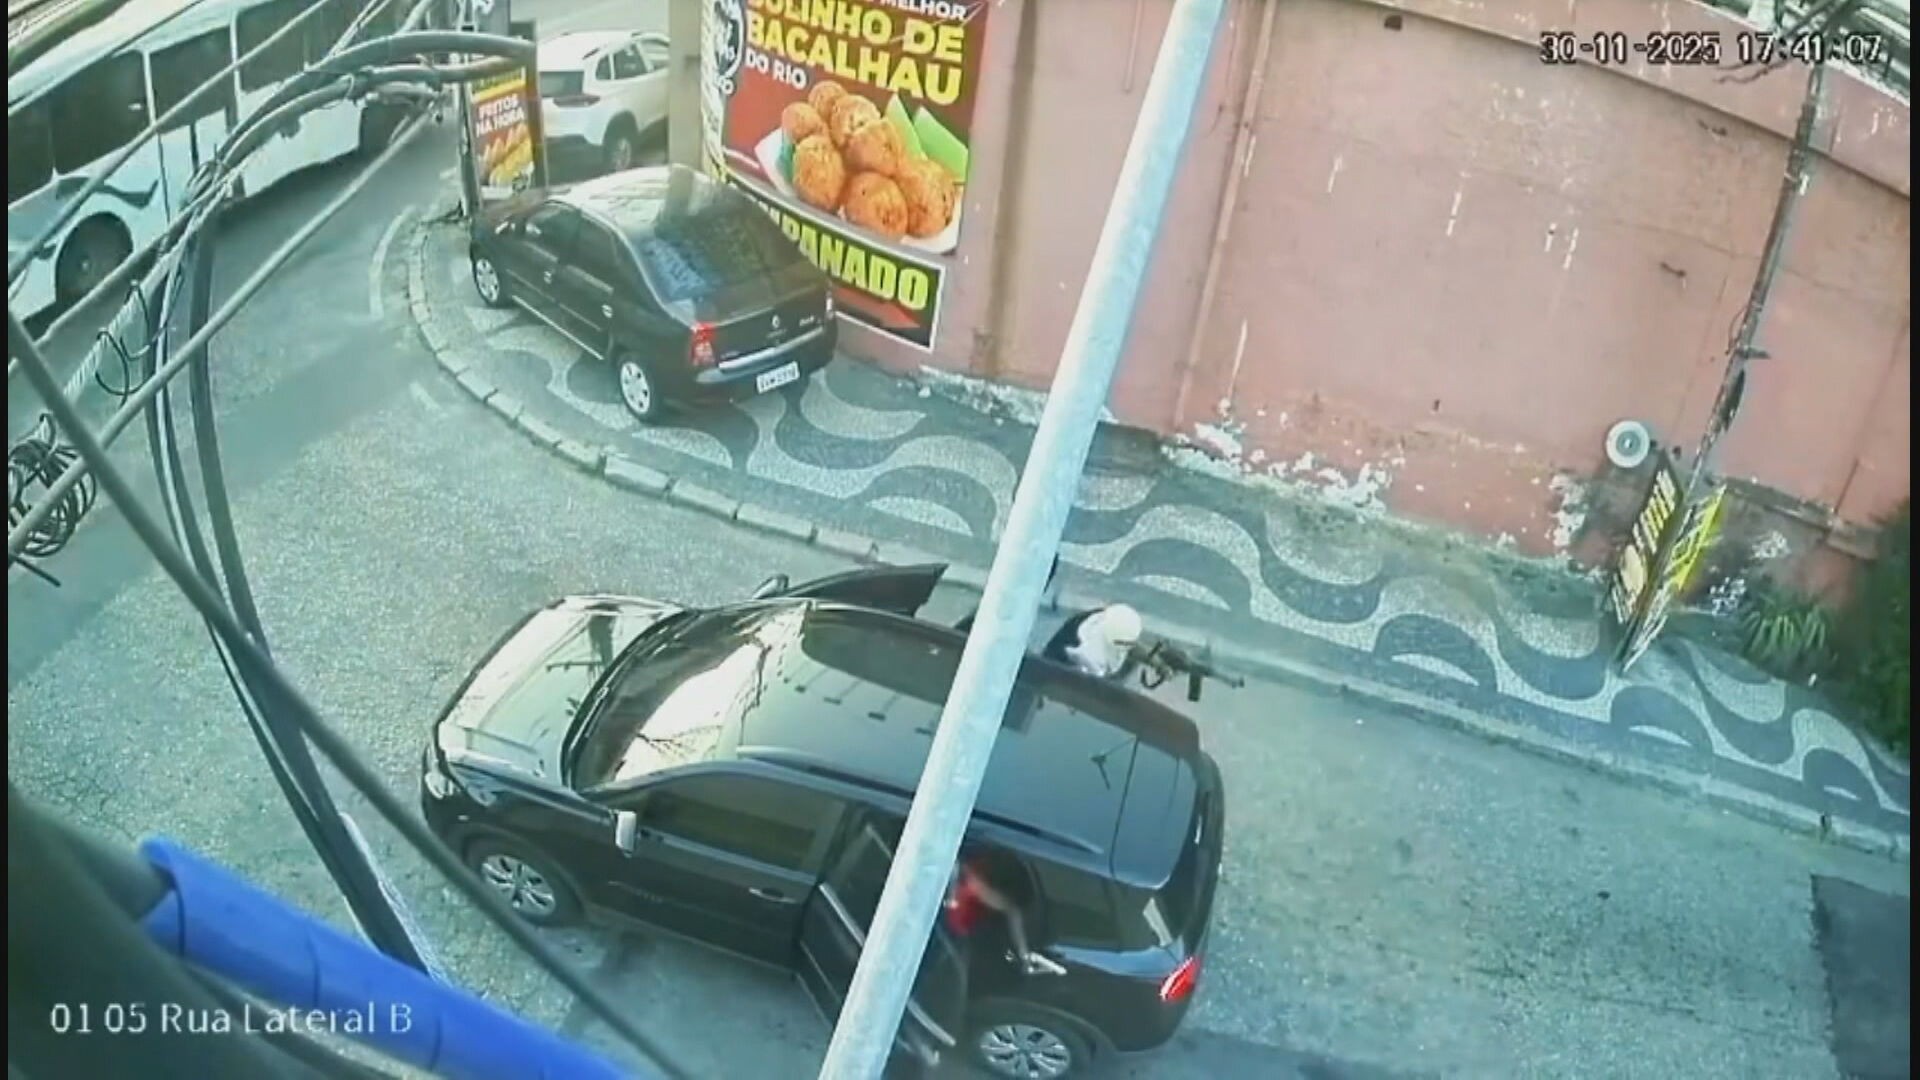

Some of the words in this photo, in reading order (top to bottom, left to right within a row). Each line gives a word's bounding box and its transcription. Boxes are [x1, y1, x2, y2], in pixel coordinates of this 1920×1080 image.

[746, 0, 892, 45] OLINHO
[902, 17, 964, 62] DE
[746, 9, 962, 105] BACALHAU
[746, 47, 769, 75] DO
[773, 59, 807, 90] RIO
[744, 192, 929, 311] PANADO
